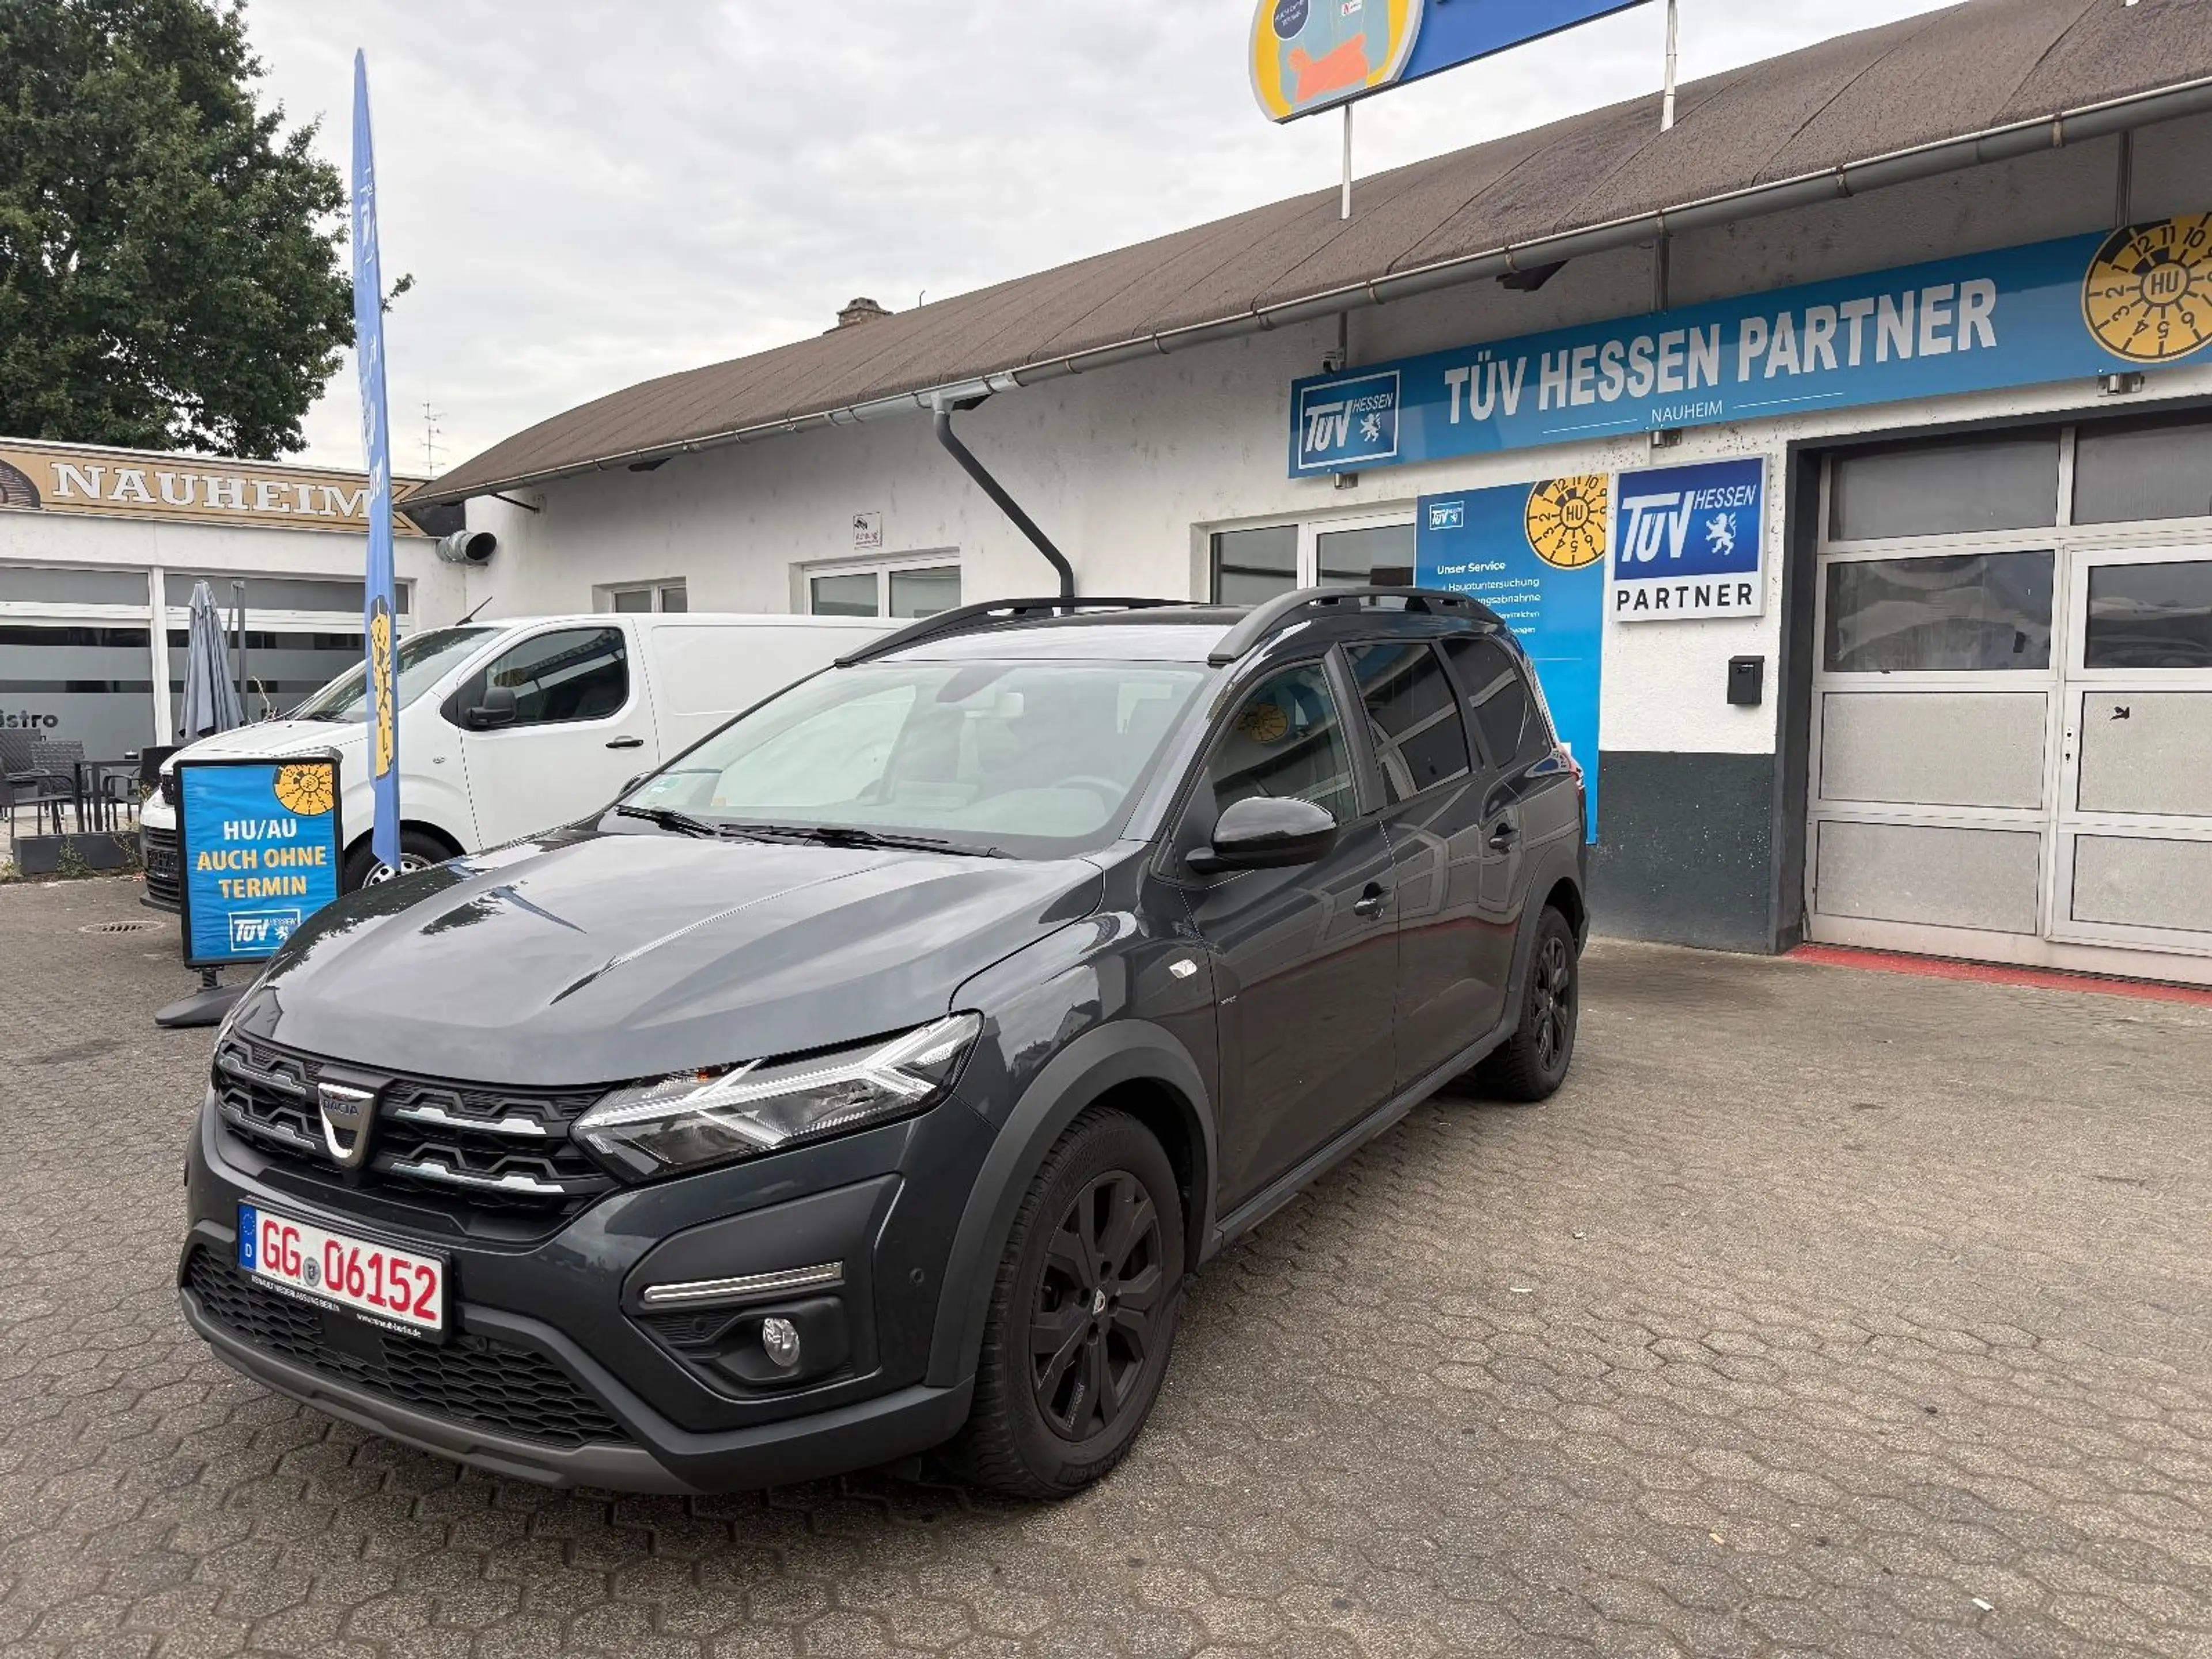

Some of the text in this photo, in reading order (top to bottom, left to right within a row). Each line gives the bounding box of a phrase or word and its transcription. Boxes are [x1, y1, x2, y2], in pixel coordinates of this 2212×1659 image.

[2161, 226, 2175, 244] 11
[2183, 227, 2206, 248] 10
[2129, 236, 2155, 257] 12
[2105, 285, 2124, 298] 2
[2151, 270, 2179, 296] HU
[2112, 305, 2130, 321] 3
[2133, 319, 2149, 336] 4
[2157, 321, 2170, 339] 5
[1445, 278, 1997, 424] TÜV HESSEN PARTNER
[1652, 400, 1722, 423] NAUHEIM
[1305, 392, 1393, 452] TÜV HESSEN
[51, 463, 370, 518] NAUHEIM
[1553, 479, 1568, 493] 12
[1585, 475, 1599, 488] 10
[1566, 505, 1583, 521] HU
[1622, 485, 1756, 562] TÜV HESSEN
[1437, 560, 1506, 574] Unser Service
[1449, 578, 1540, 592] Hauptuntersuchung
[1475, 593, 1541, 606] ungsabnahme
[1616, 583, 1752, 611] PARTNER
[224, 818, 297, 840] HU/AU
[197, 846, 327, 871] AUCH OHNE
[218, 875, 306, 899] TERMIN
[323, 1099, 358, 1115] DACIA
[245, 1243, 252, 1257] D
[263, 1219, 437, 1321] GG 06152
